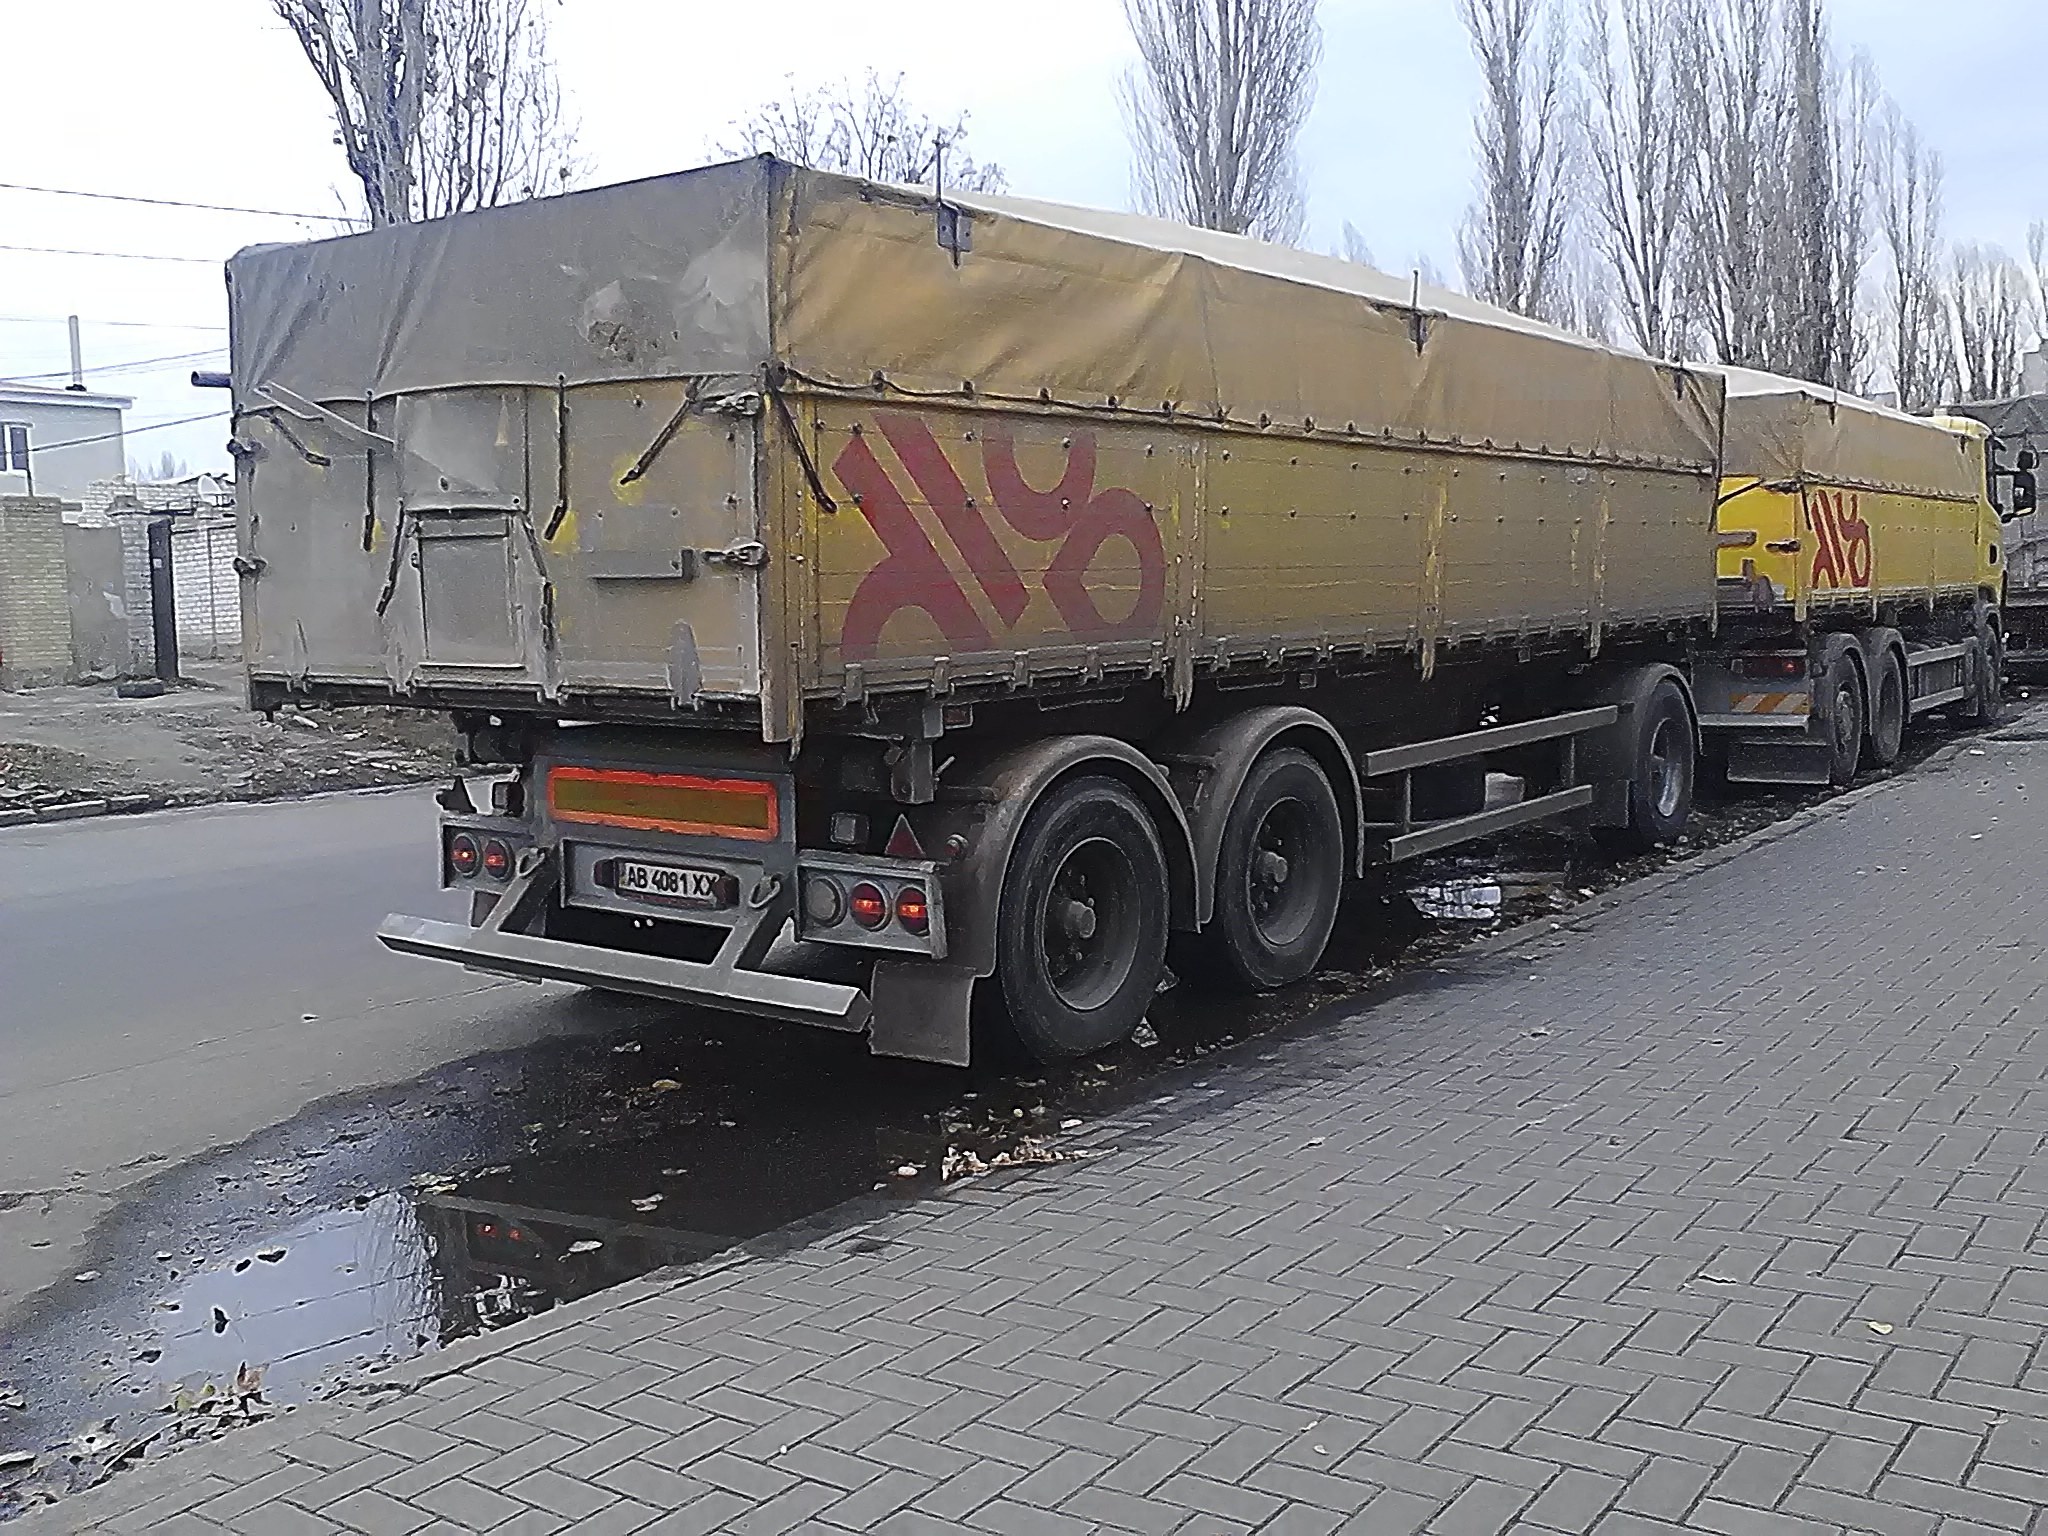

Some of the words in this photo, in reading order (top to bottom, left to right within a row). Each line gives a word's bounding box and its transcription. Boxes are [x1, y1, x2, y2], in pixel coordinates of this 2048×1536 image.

[627, 866, 648, 889] AB
[651, 869, 688, 895] 4081
[692, 873, 717, 896] XX
